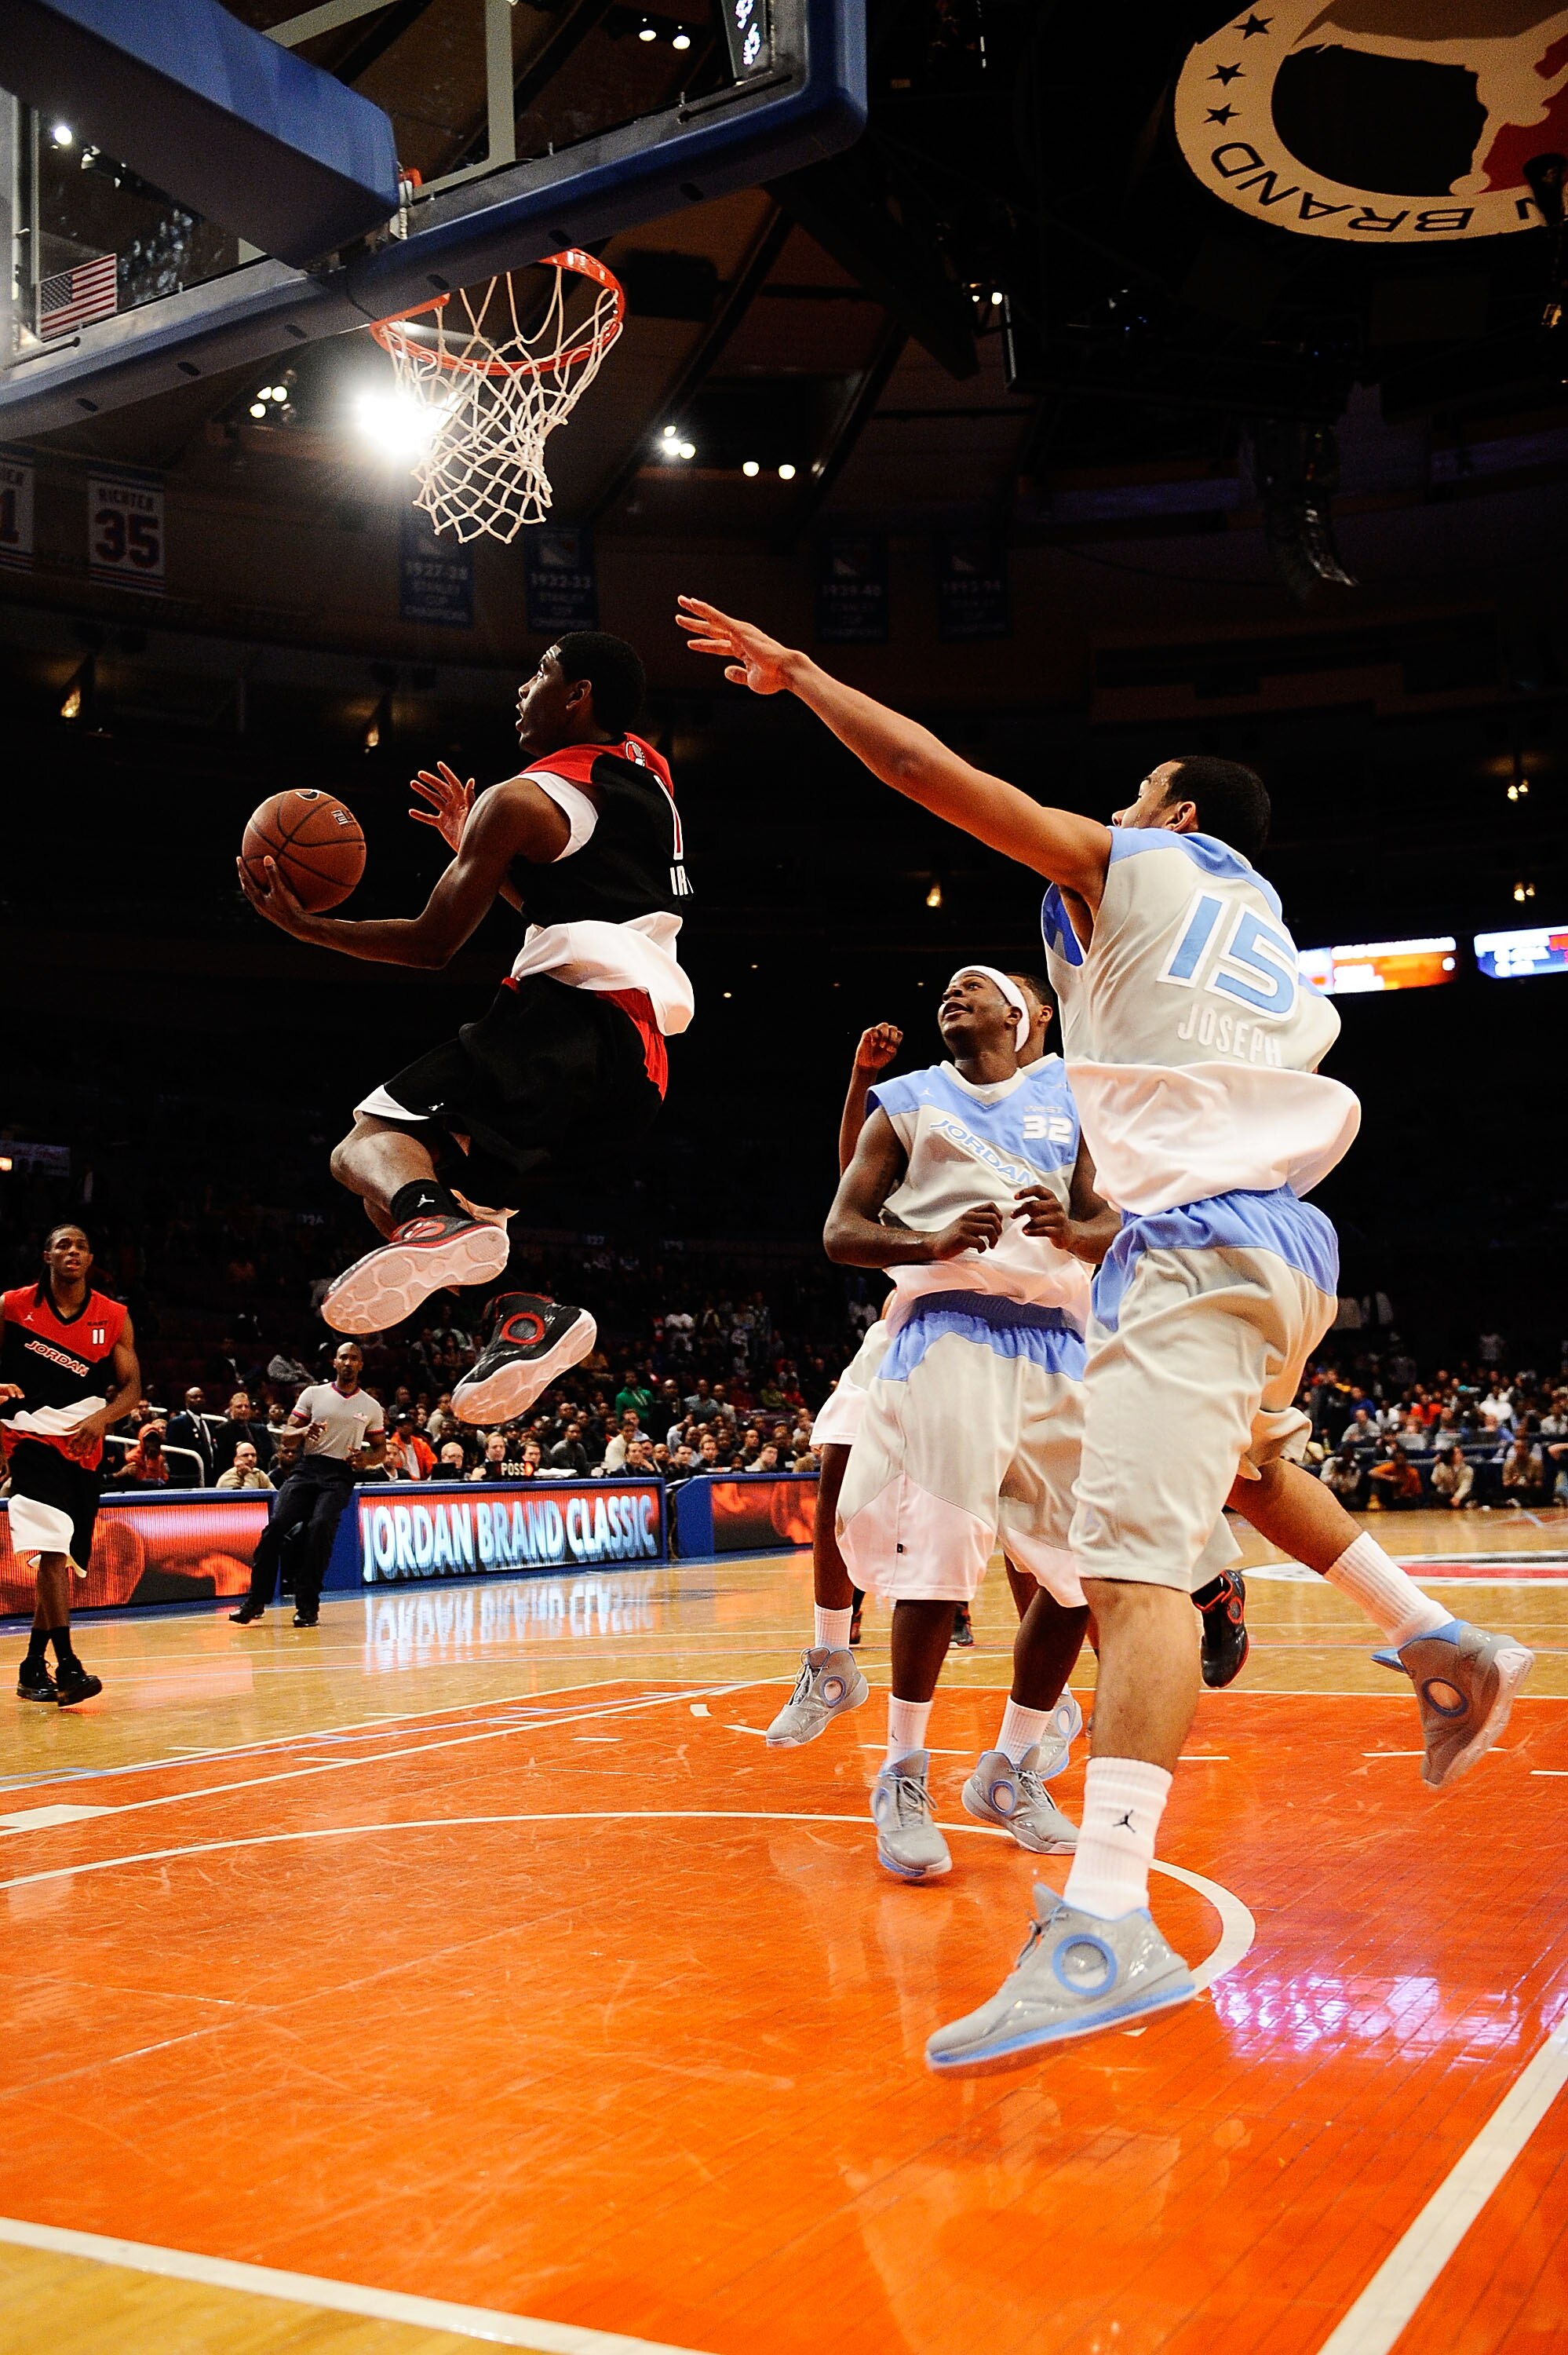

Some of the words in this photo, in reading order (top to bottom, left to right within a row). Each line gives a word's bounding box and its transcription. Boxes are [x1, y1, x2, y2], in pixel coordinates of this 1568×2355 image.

[1212, 142, 1474, 232] BRAND
[95, 509, 159, 568] 35
[1156, 888, 1299, 1021] 15
[1178, 1003, 1282, 1068] JOSEPH
[929, 1118, 1042, 1188] JORDAN
[1023, 1115, 1074, 1145] 32
[24, 1340, 89, 1377] JORDAN
[92, 1328, 104, 1345] 11
[501, 1462, 524, 1476] POSS
[362, 1502, 473, 1582] JORDAN
[476, 1499, 565, 1566] BRAND
[567, 1494, 658, 1559] CLASSIC
